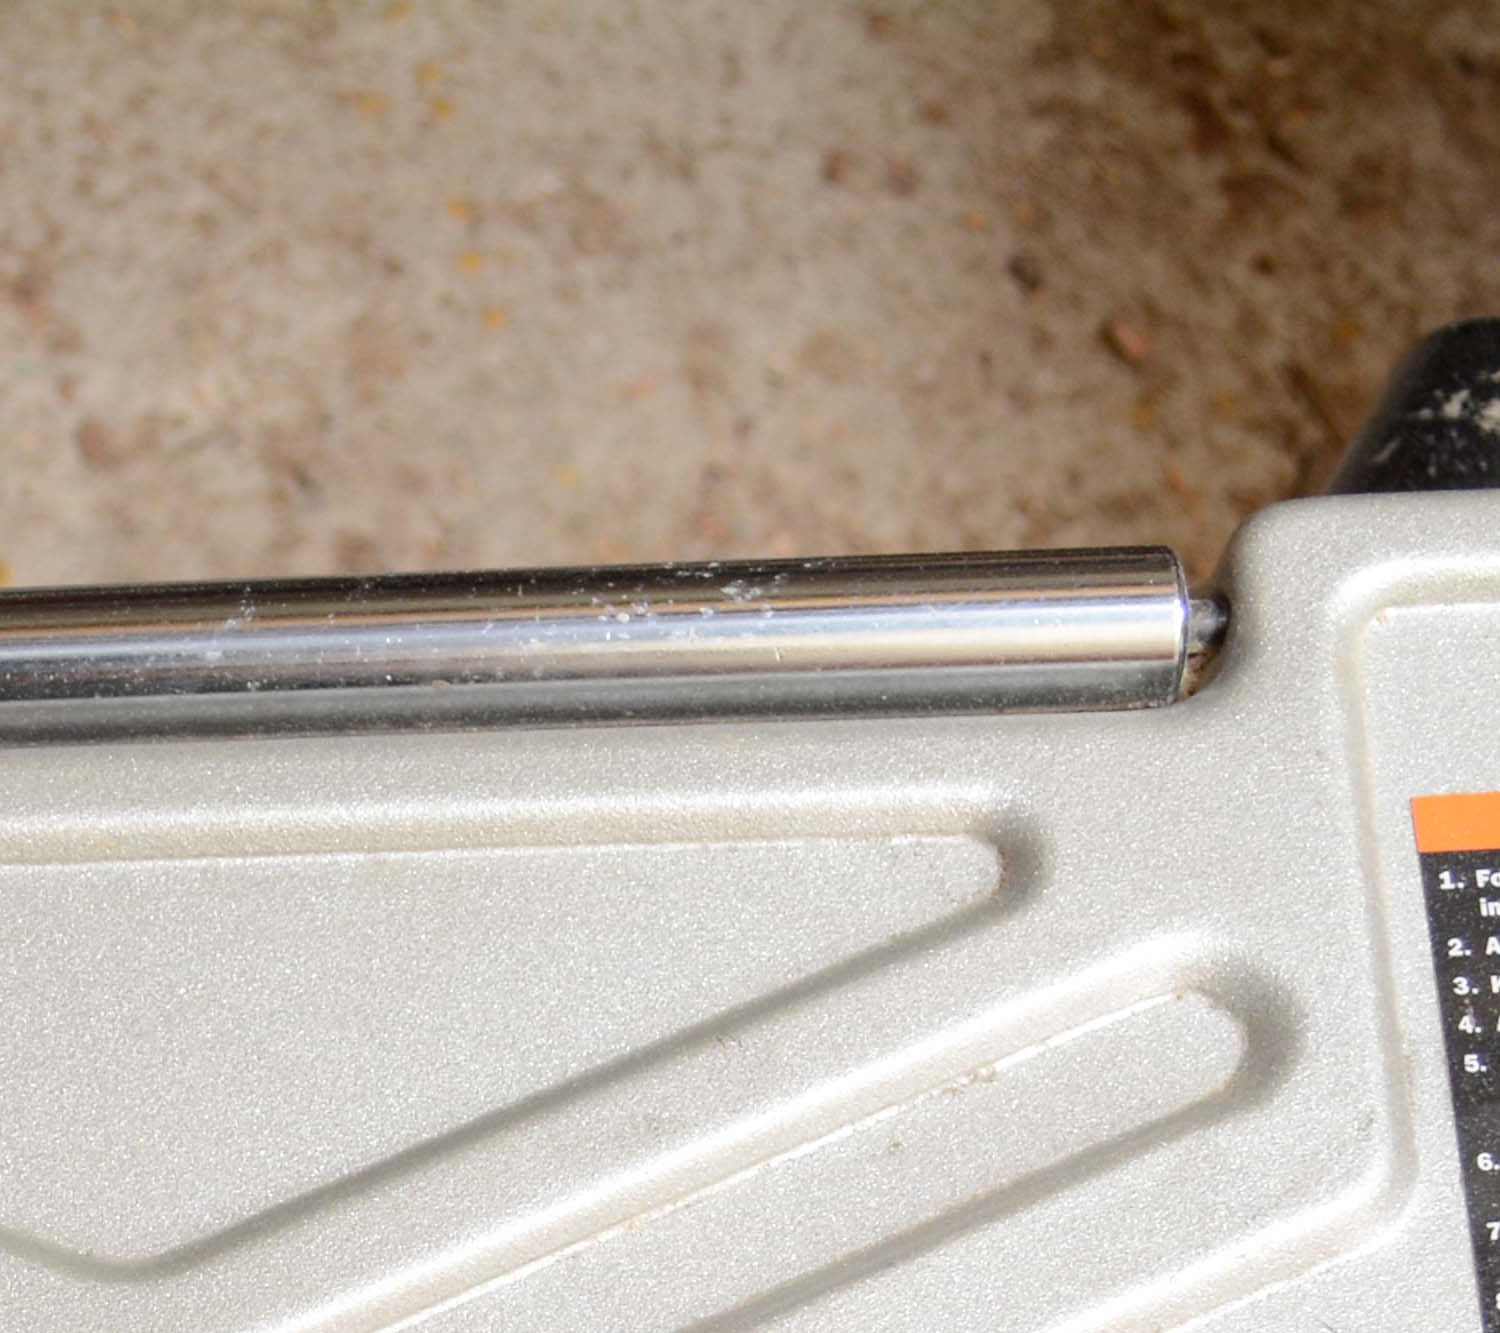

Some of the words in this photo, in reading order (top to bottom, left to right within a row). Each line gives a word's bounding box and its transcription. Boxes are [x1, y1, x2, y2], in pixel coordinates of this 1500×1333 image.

[1438, 870, 1465, 890] 1.
[1447, 937, 1472, 957] 2.
[1452, 976, 1479, 996] 3.
[1458, 1014, 1482, 1034] 4.
[1463, 1054, 1487, 1073] 5.
